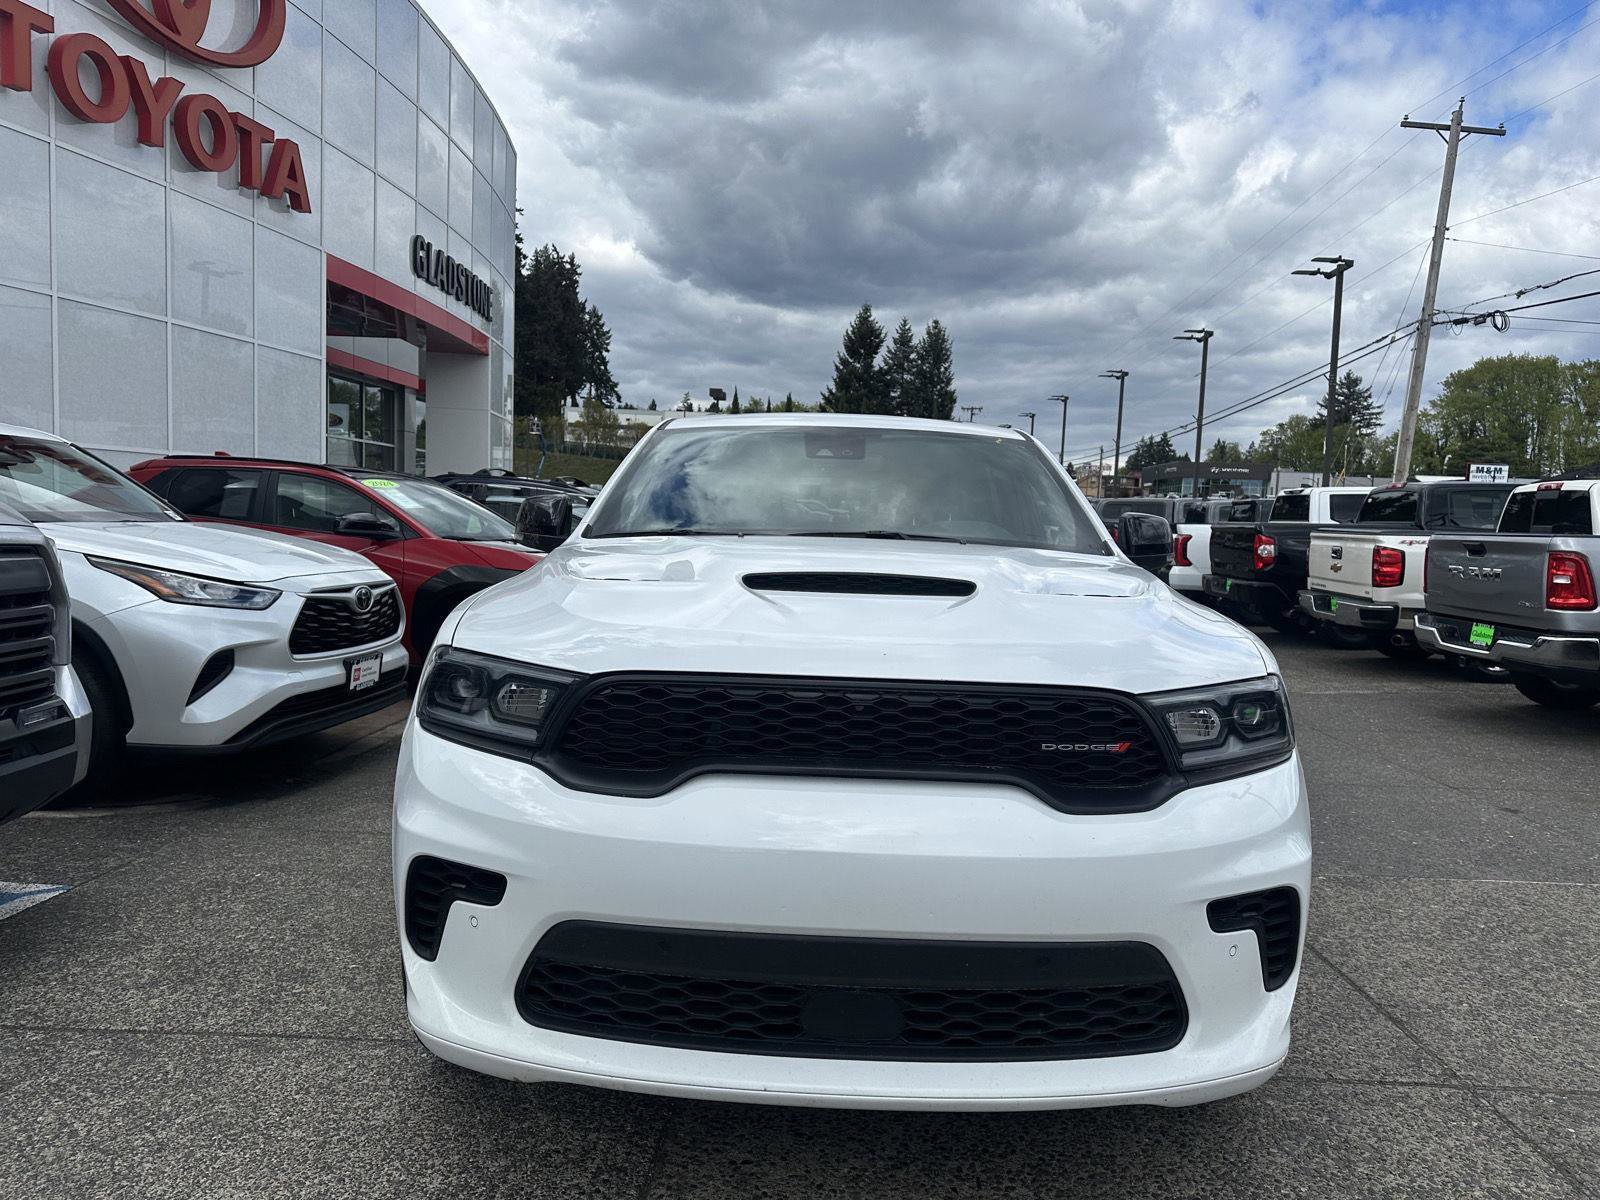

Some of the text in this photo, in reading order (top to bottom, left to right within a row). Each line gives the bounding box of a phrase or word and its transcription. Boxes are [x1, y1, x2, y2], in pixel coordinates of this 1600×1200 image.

[0, 0, 312, 214] TOYOTA
[1475, 466, 1503, 475] M&M
[1448, 565, 1502, 581] RAM
[1041, 743, 1120, 752] DODGE
